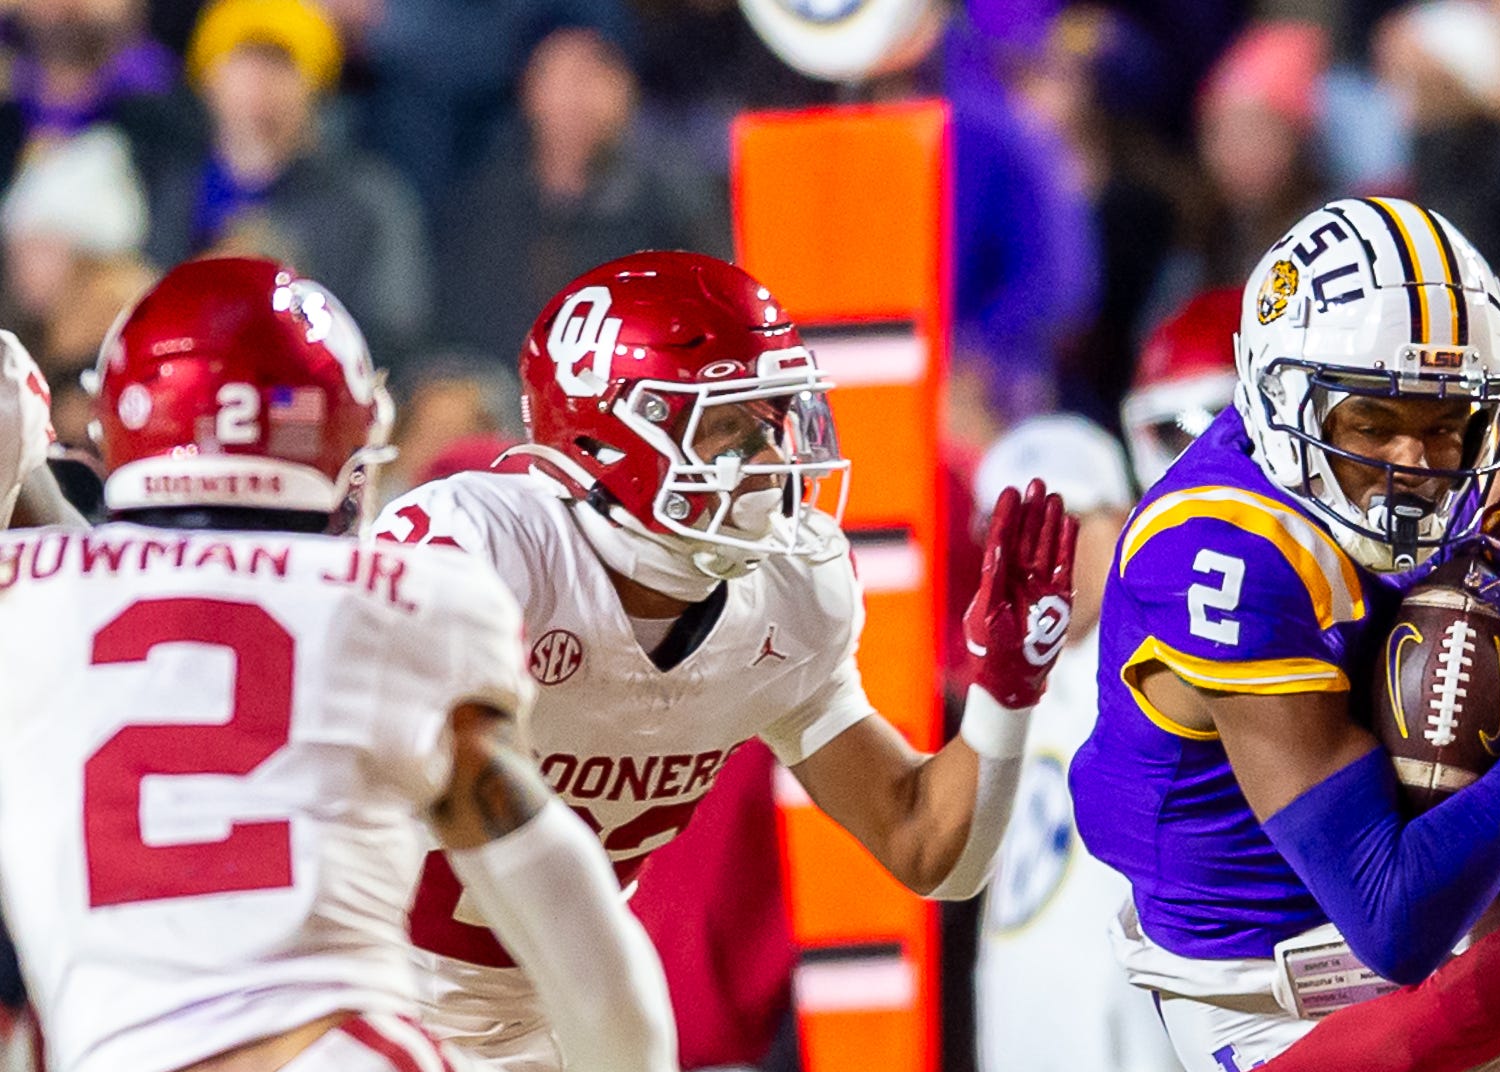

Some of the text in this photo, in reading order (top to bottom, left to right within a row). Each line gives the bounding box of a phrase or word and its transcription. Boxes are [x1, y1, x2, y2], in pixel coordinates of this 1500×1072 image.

[1419, 350, 1464, 369] LSU
[216, 382, 261, 444] 2
[1187, 548, 1246, 646] 2
[530, 629, 583, 686] SEC
[84, 598, 294, 908] 2
